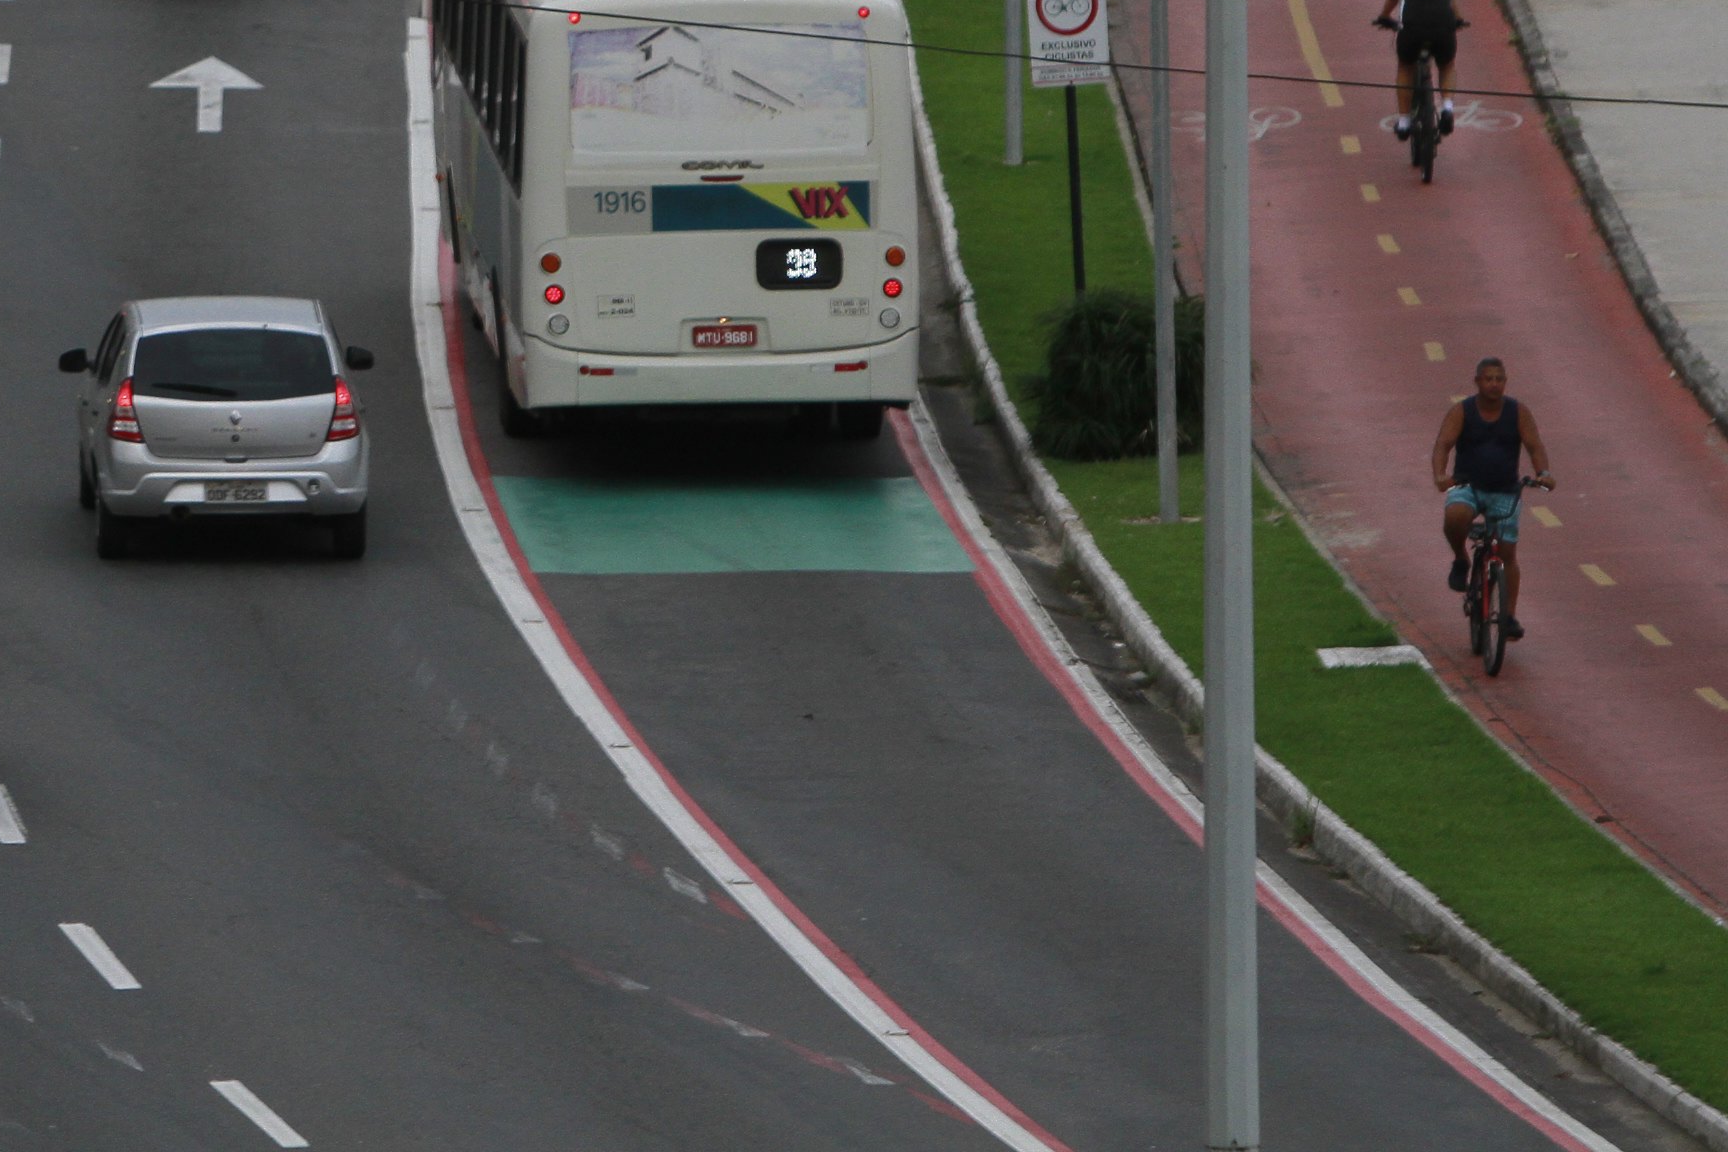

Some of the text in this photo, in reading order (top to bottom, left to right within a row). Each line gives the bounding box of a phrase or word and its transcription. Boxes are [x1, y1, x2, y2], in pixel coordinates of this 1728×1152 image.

[1041, 39, 1097, 50] EXCLUSIVO
[1045, 50, 1095, 61] CICLISTAS
[593, 191, 647, 215] 1916
[788, 185, 850, 220] VIX
